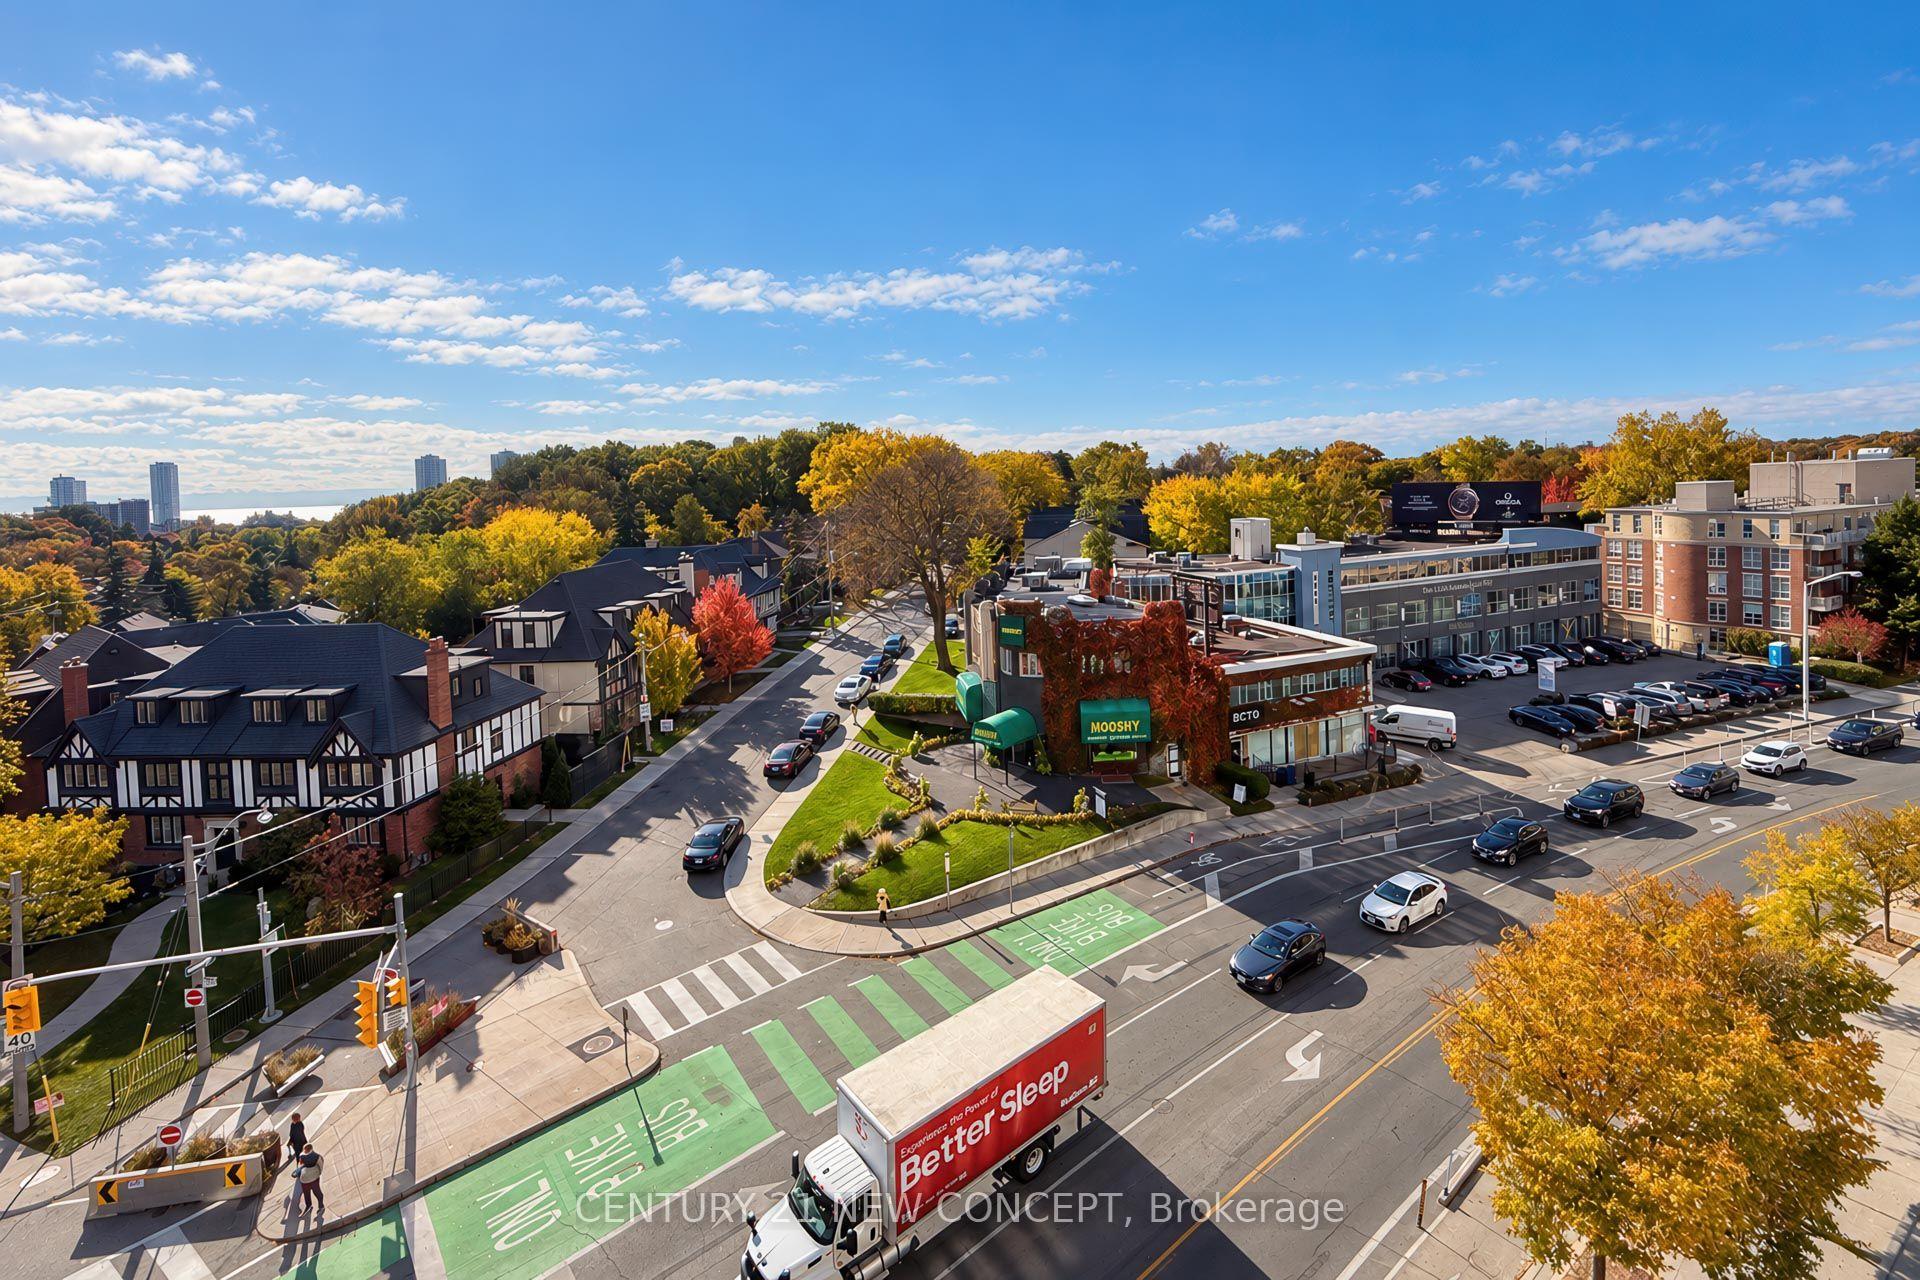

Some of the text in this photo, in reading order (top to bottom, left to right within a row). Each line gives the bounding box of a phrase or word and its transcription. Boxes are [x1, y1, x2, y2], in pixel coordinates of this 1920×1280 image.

[1090, 720, 1140, 733] MOOSHY
[1232, 709, 1260, 723] BCTO
[1049, 913, 1109, 946] BIKE
[1086, 903, 1135, 929] BUS
[8, 1032, 31, 1046] 40
[637, 1097, 709, 1153] BUS
[900, 1109, 995, 1193] Better
[1000, 1060, 1069, 1122] Sleep
[565, 1122, 646, 1202] BIKE
[476, 1169, 562, 1251] ONLY
